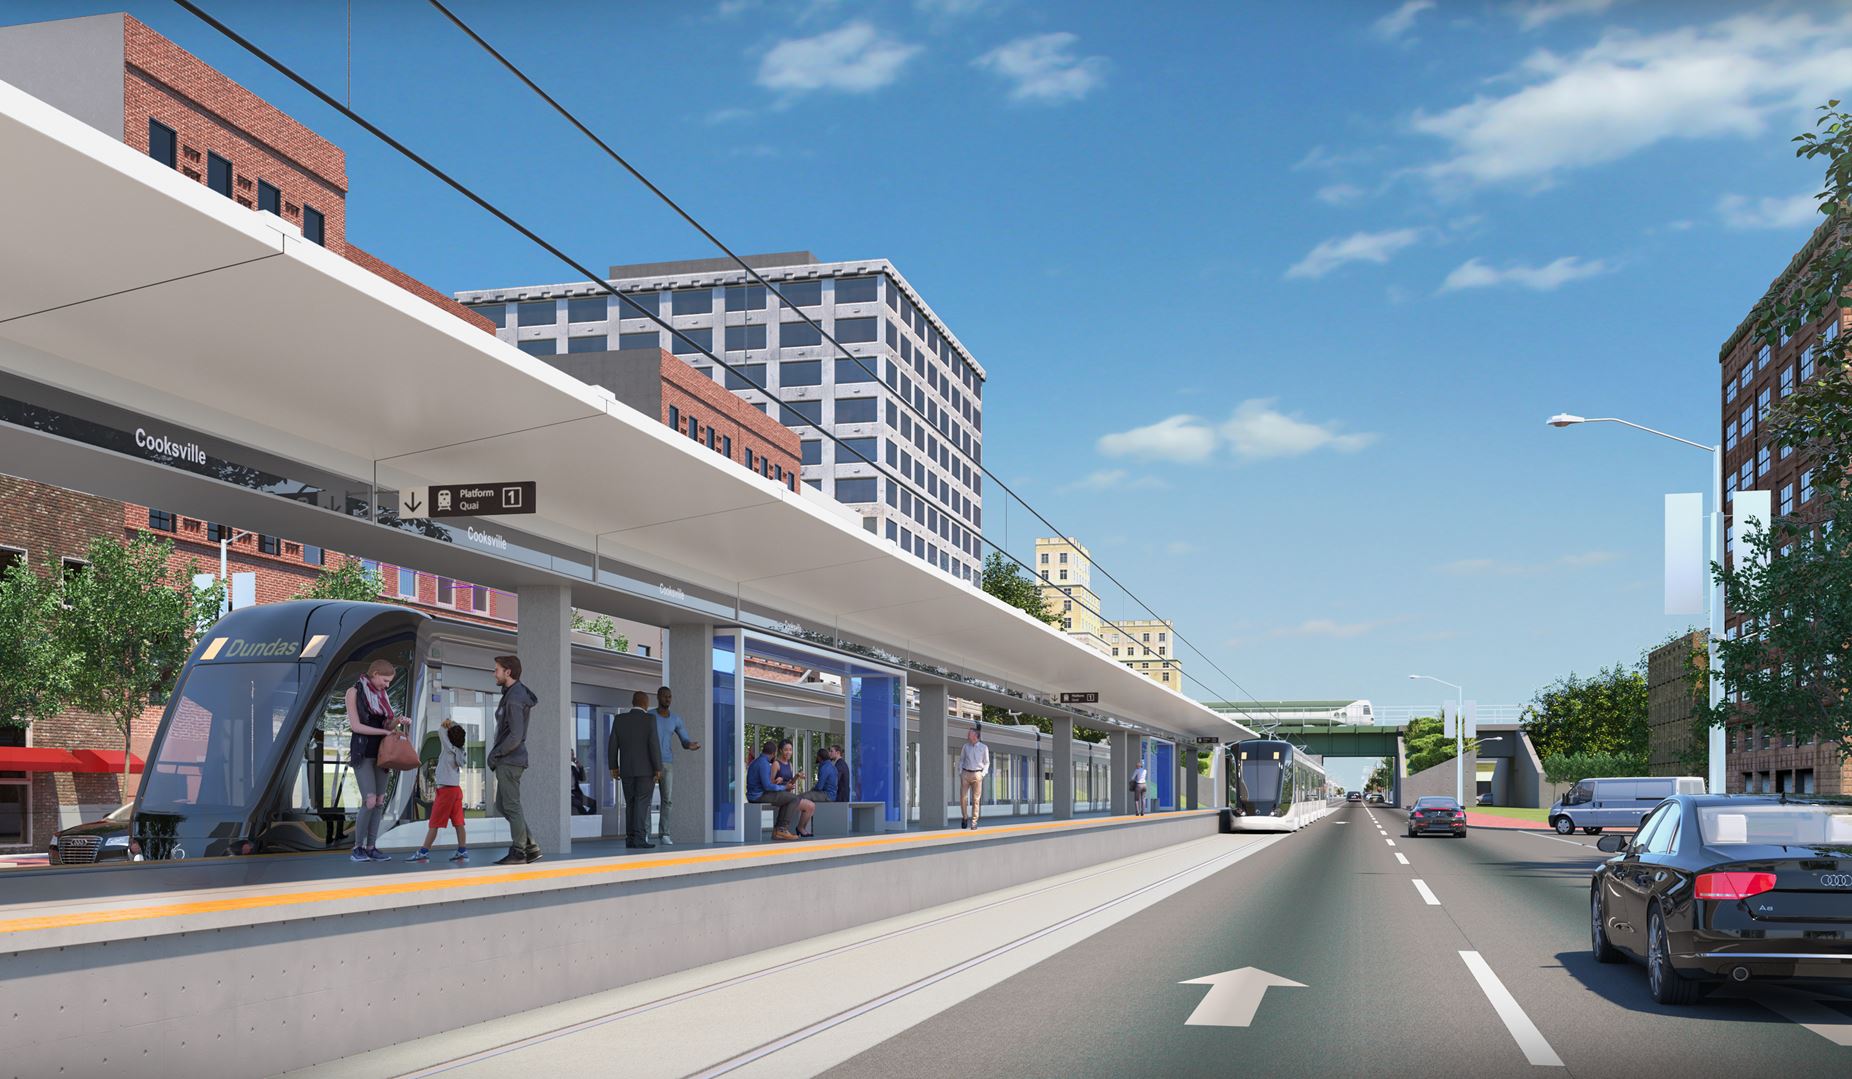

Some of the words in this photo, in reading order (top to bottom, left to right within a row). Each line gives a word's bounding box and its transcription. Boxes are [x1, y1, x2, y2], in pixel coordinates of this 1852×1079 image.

[135, 427, 206, 465] Cooksville
[460, 489, 494, 498] Platform
[507, 490, 515, 504] 1
[460, 501, 479, 511] Quai
[467, 526, 507, 550] Cooksville
[225, 638, 298, 657] Dundas
